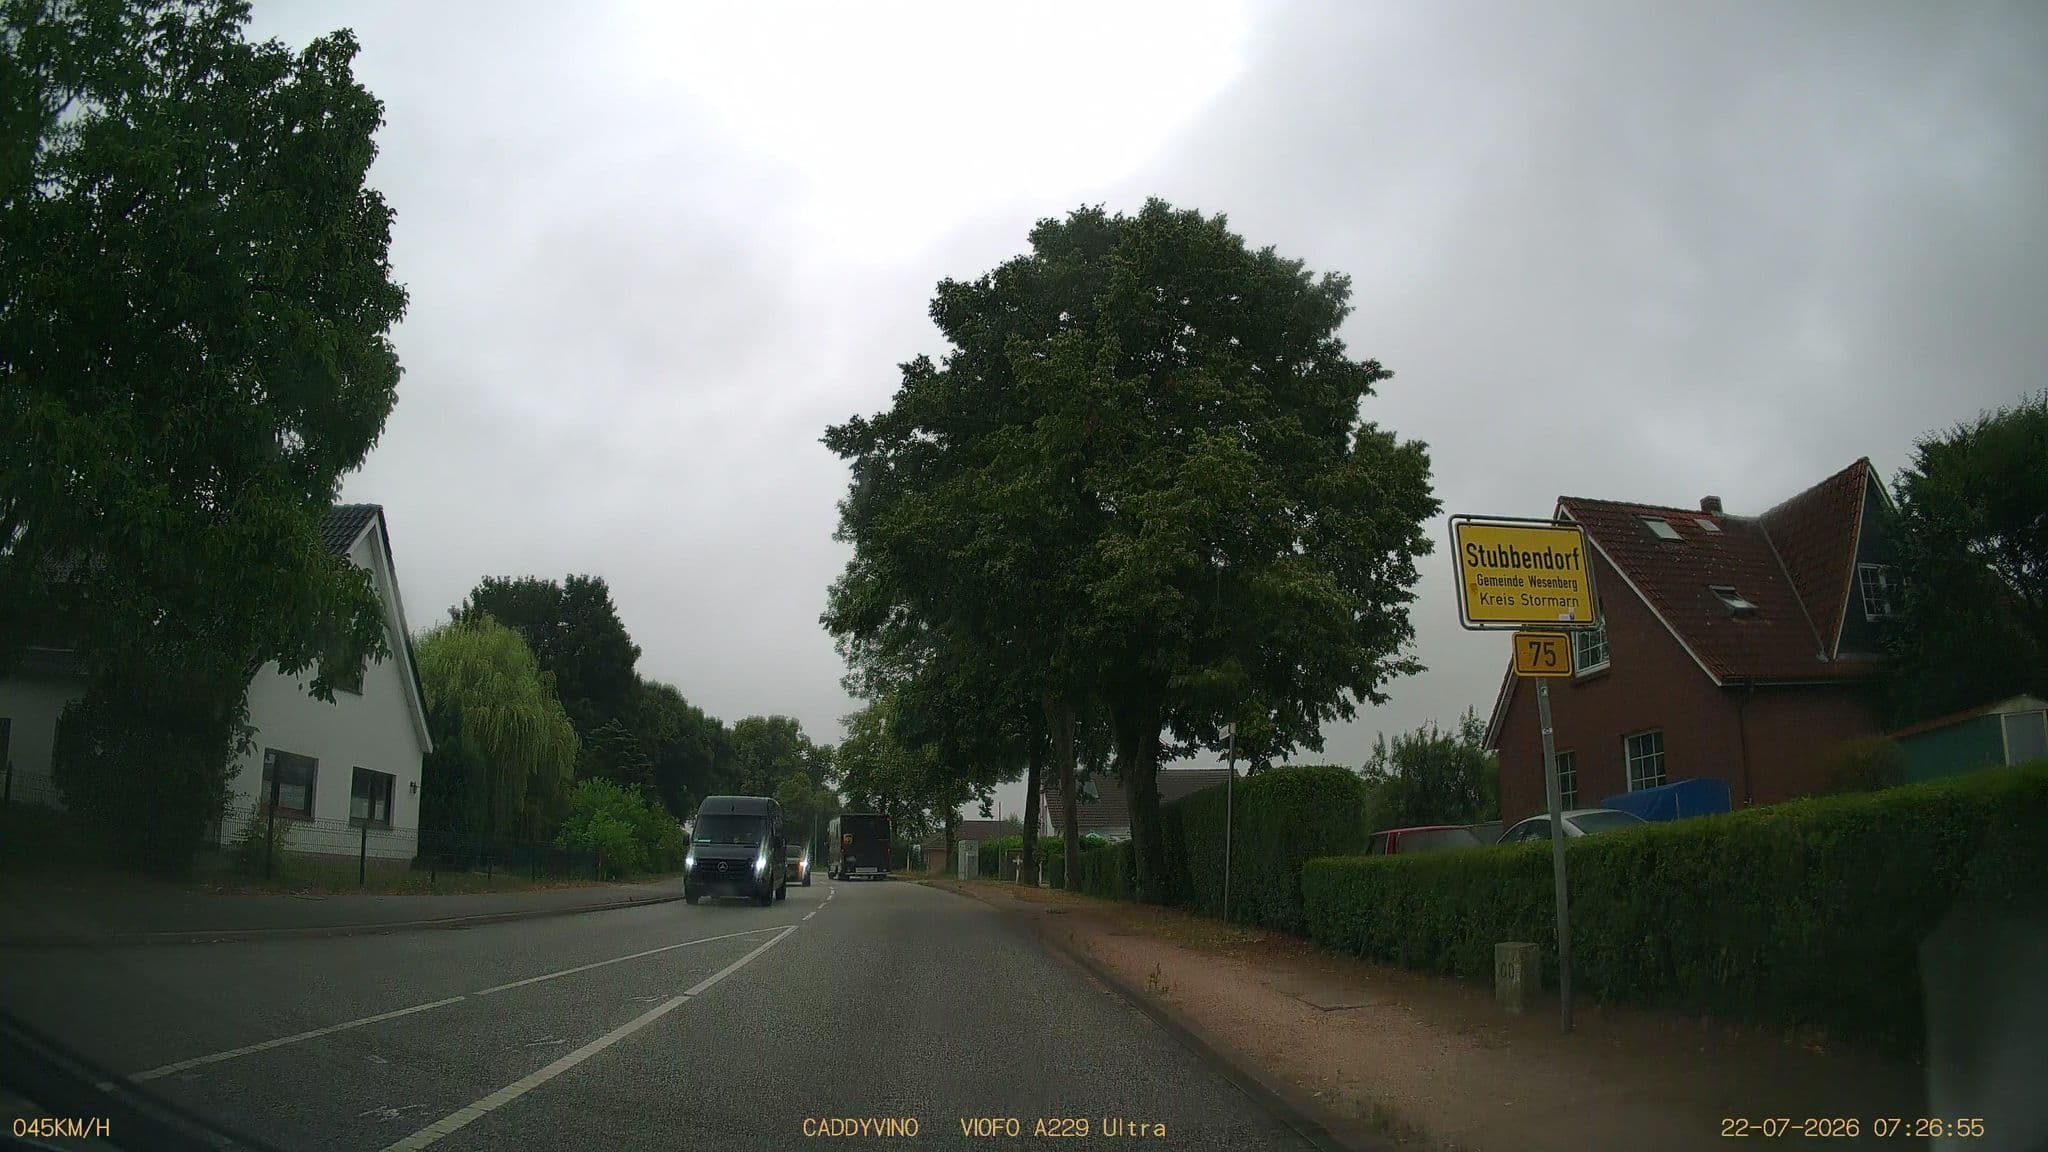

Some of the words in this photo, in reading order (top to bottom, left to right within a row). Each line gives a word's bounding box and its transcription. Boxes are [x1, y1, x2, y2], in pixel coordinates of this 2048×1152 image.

[1466, 542, 1580, 570] Stubbendorf
[1476, 573, 1524, 588] Gemeinde
[1528, 575, 1578, 592] Wesenberg
[1480, 592, 1515, 606] Kreis
[1520, 593, 1579, 608] Stormarn
[1528, 641, 1556, 667] 75
